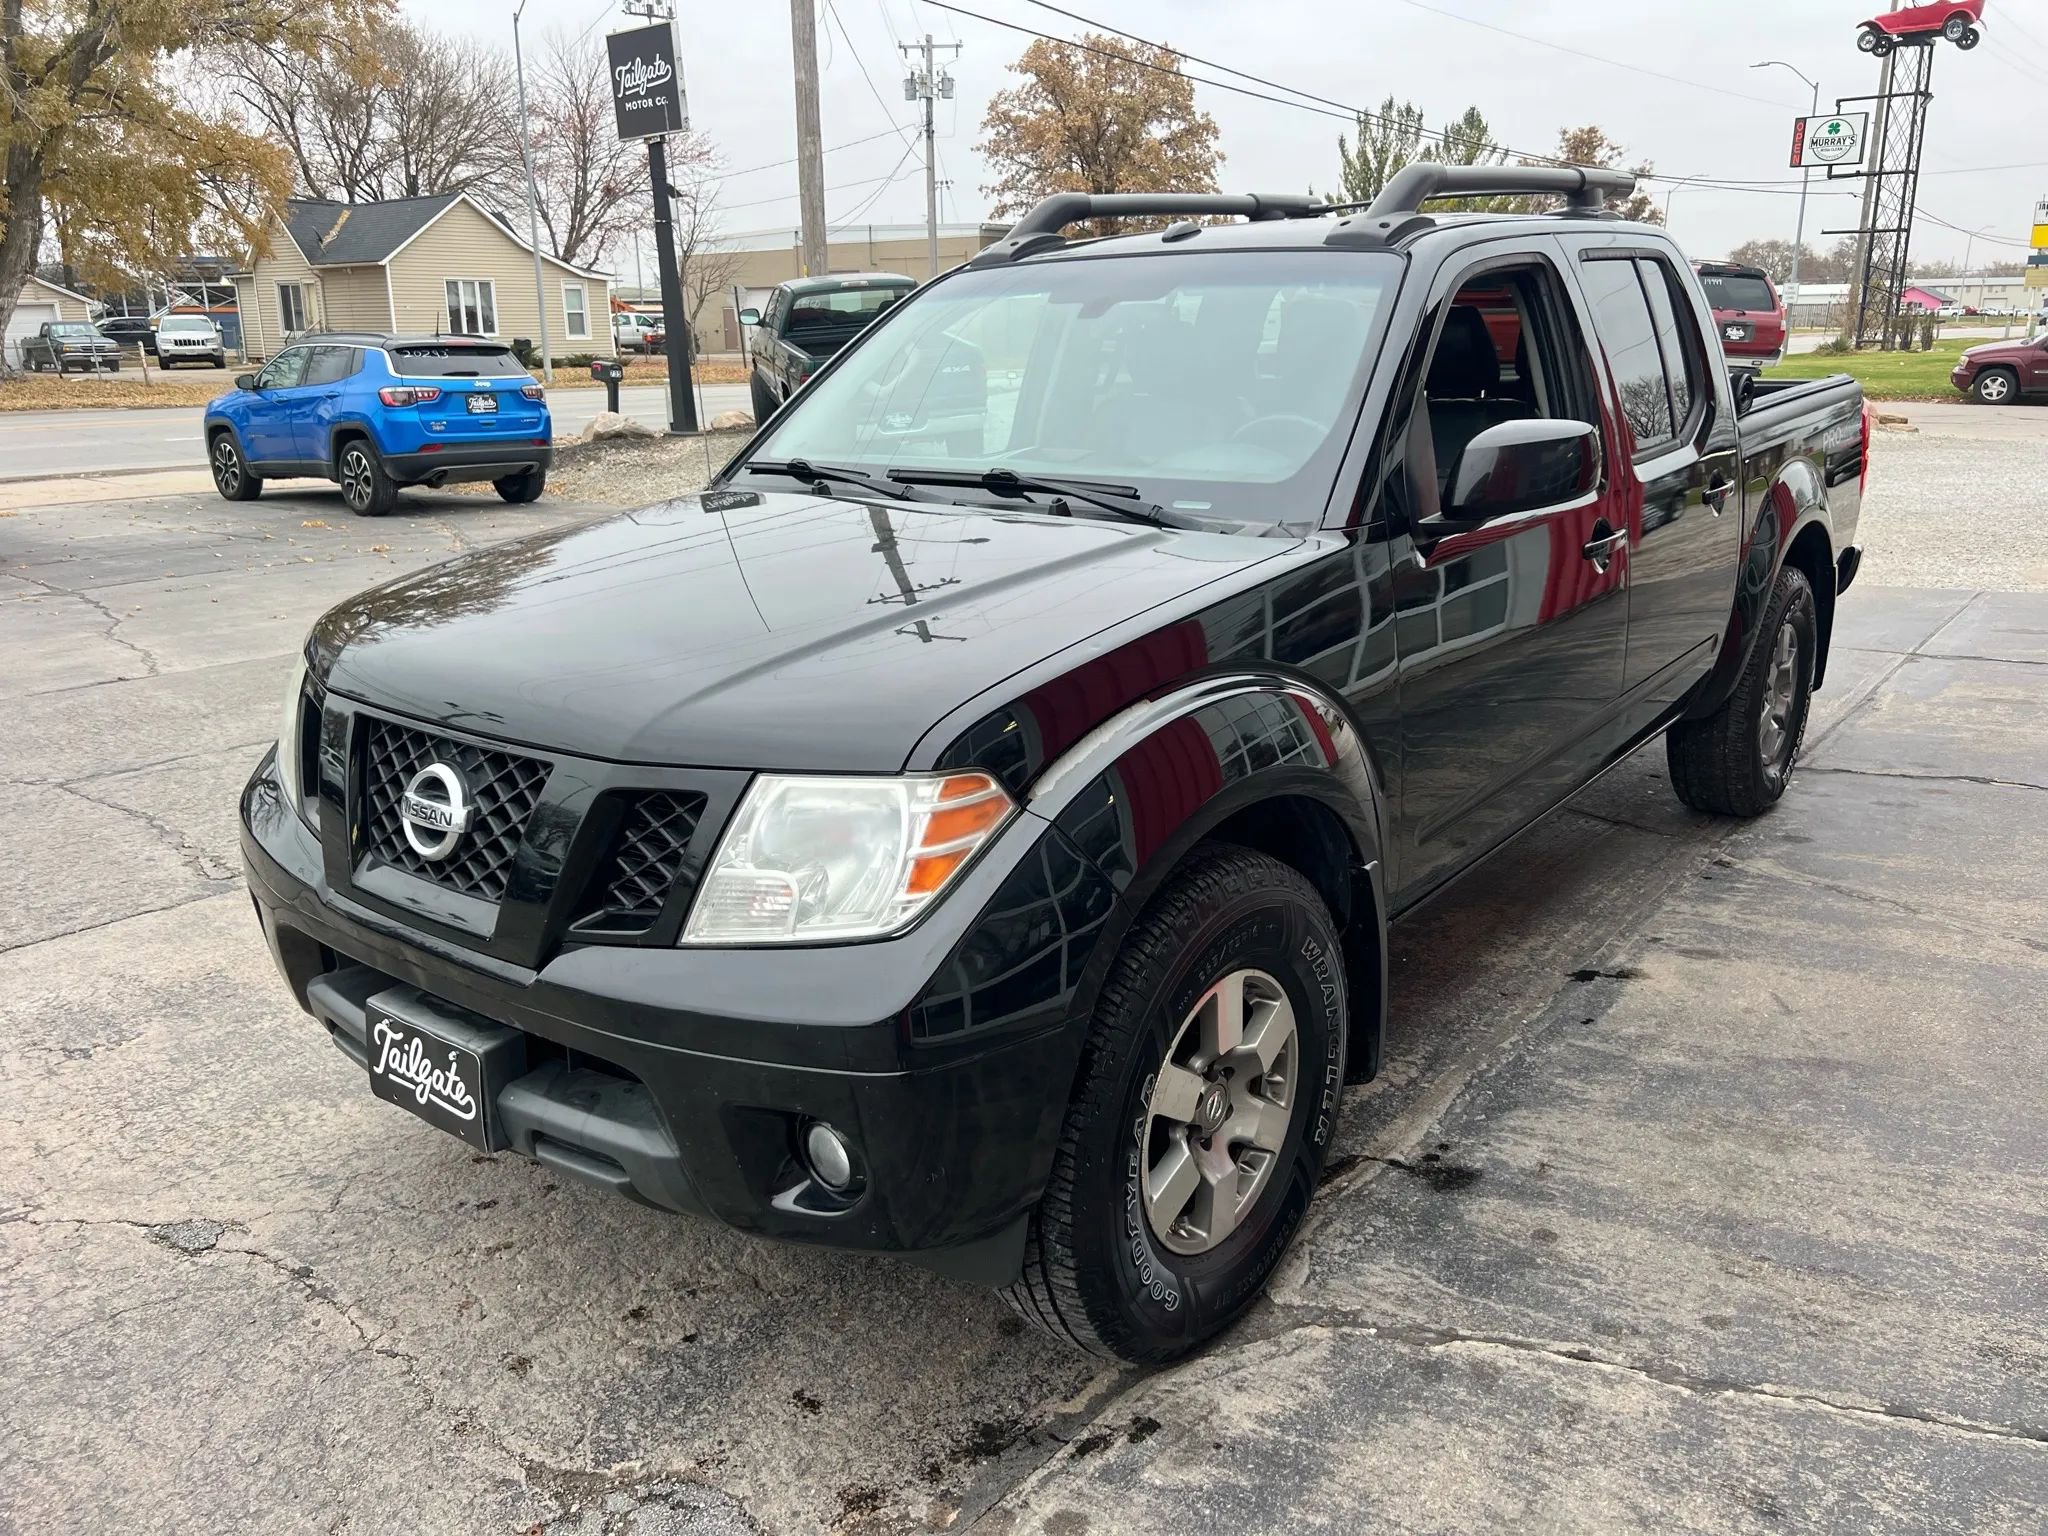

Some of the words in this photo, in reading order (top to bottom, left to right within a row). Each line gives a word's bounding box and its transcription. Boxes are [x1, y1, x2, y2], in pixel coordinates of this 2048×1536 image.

[615, 53, 672, 98] Tailgate
[625, 98, 653, 111] MOTOR
[1793, 122, 1804, 165] OPEN
[1811, 136, 1855, 147] MURRAY'S
[402, 796, 453, 827] NISSAN
[1300, 935, 1340, 1146] WRANGLER
[373, 1022, 477, 1120] Tailgate
[1124, 1073, 1180, 1312] GOODYEAR
